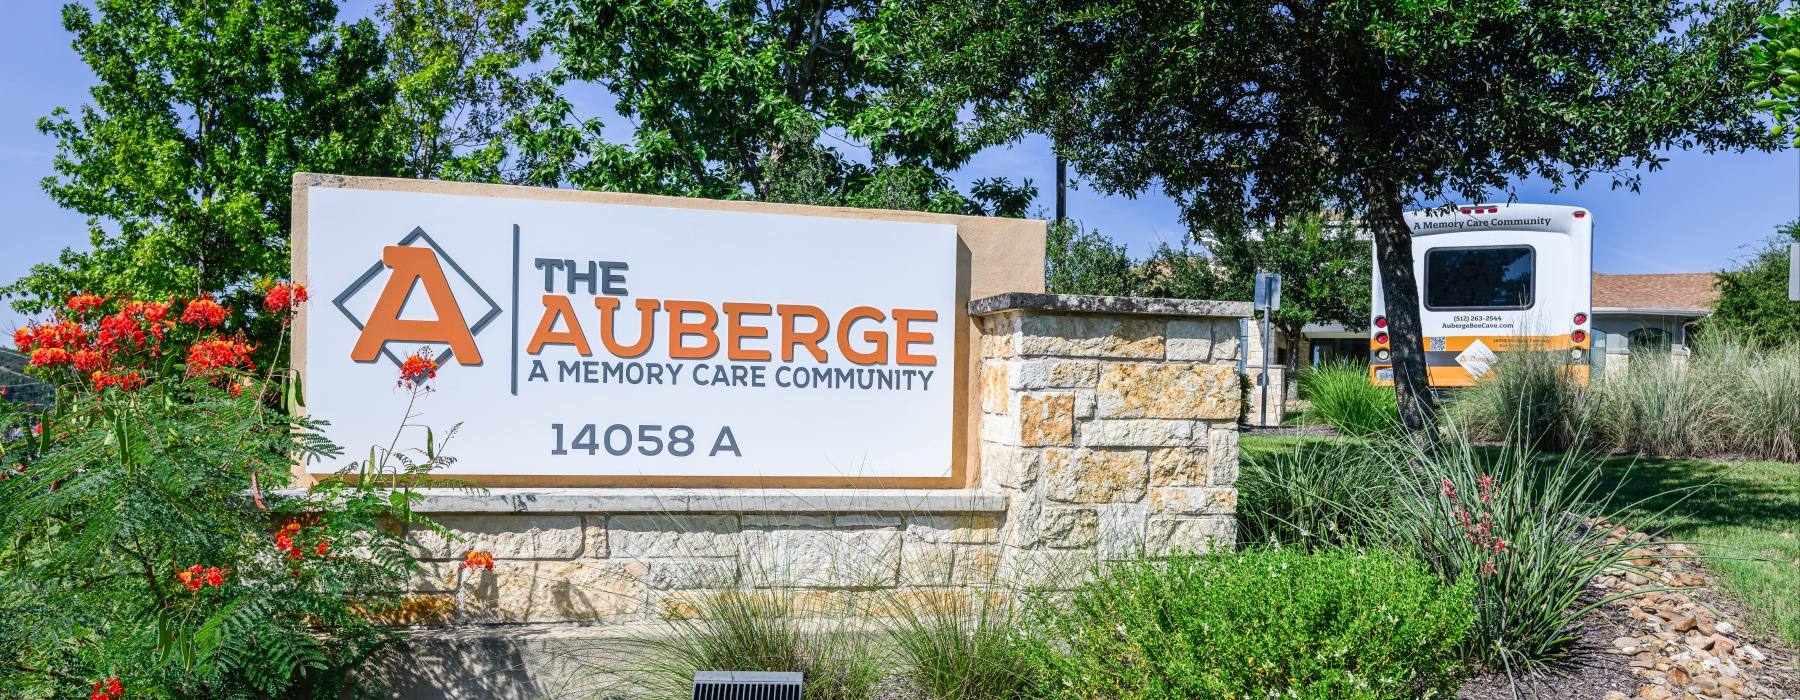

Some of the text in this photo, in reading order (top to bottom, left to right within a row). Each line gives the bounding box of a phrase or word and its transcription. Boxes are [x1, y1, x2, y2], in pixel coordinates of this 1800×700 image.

[1413, 216, 1551, 231] A Memory Care Community
[535, 258, 629, 296] THE
[350, 245, 484, 366] A
[526, 295, 938, 367] AUBERGE
[528, 360, 935, 391] A MEMORY CARE COMMUNITY
[552, 424, 743, 457] 14058 A
